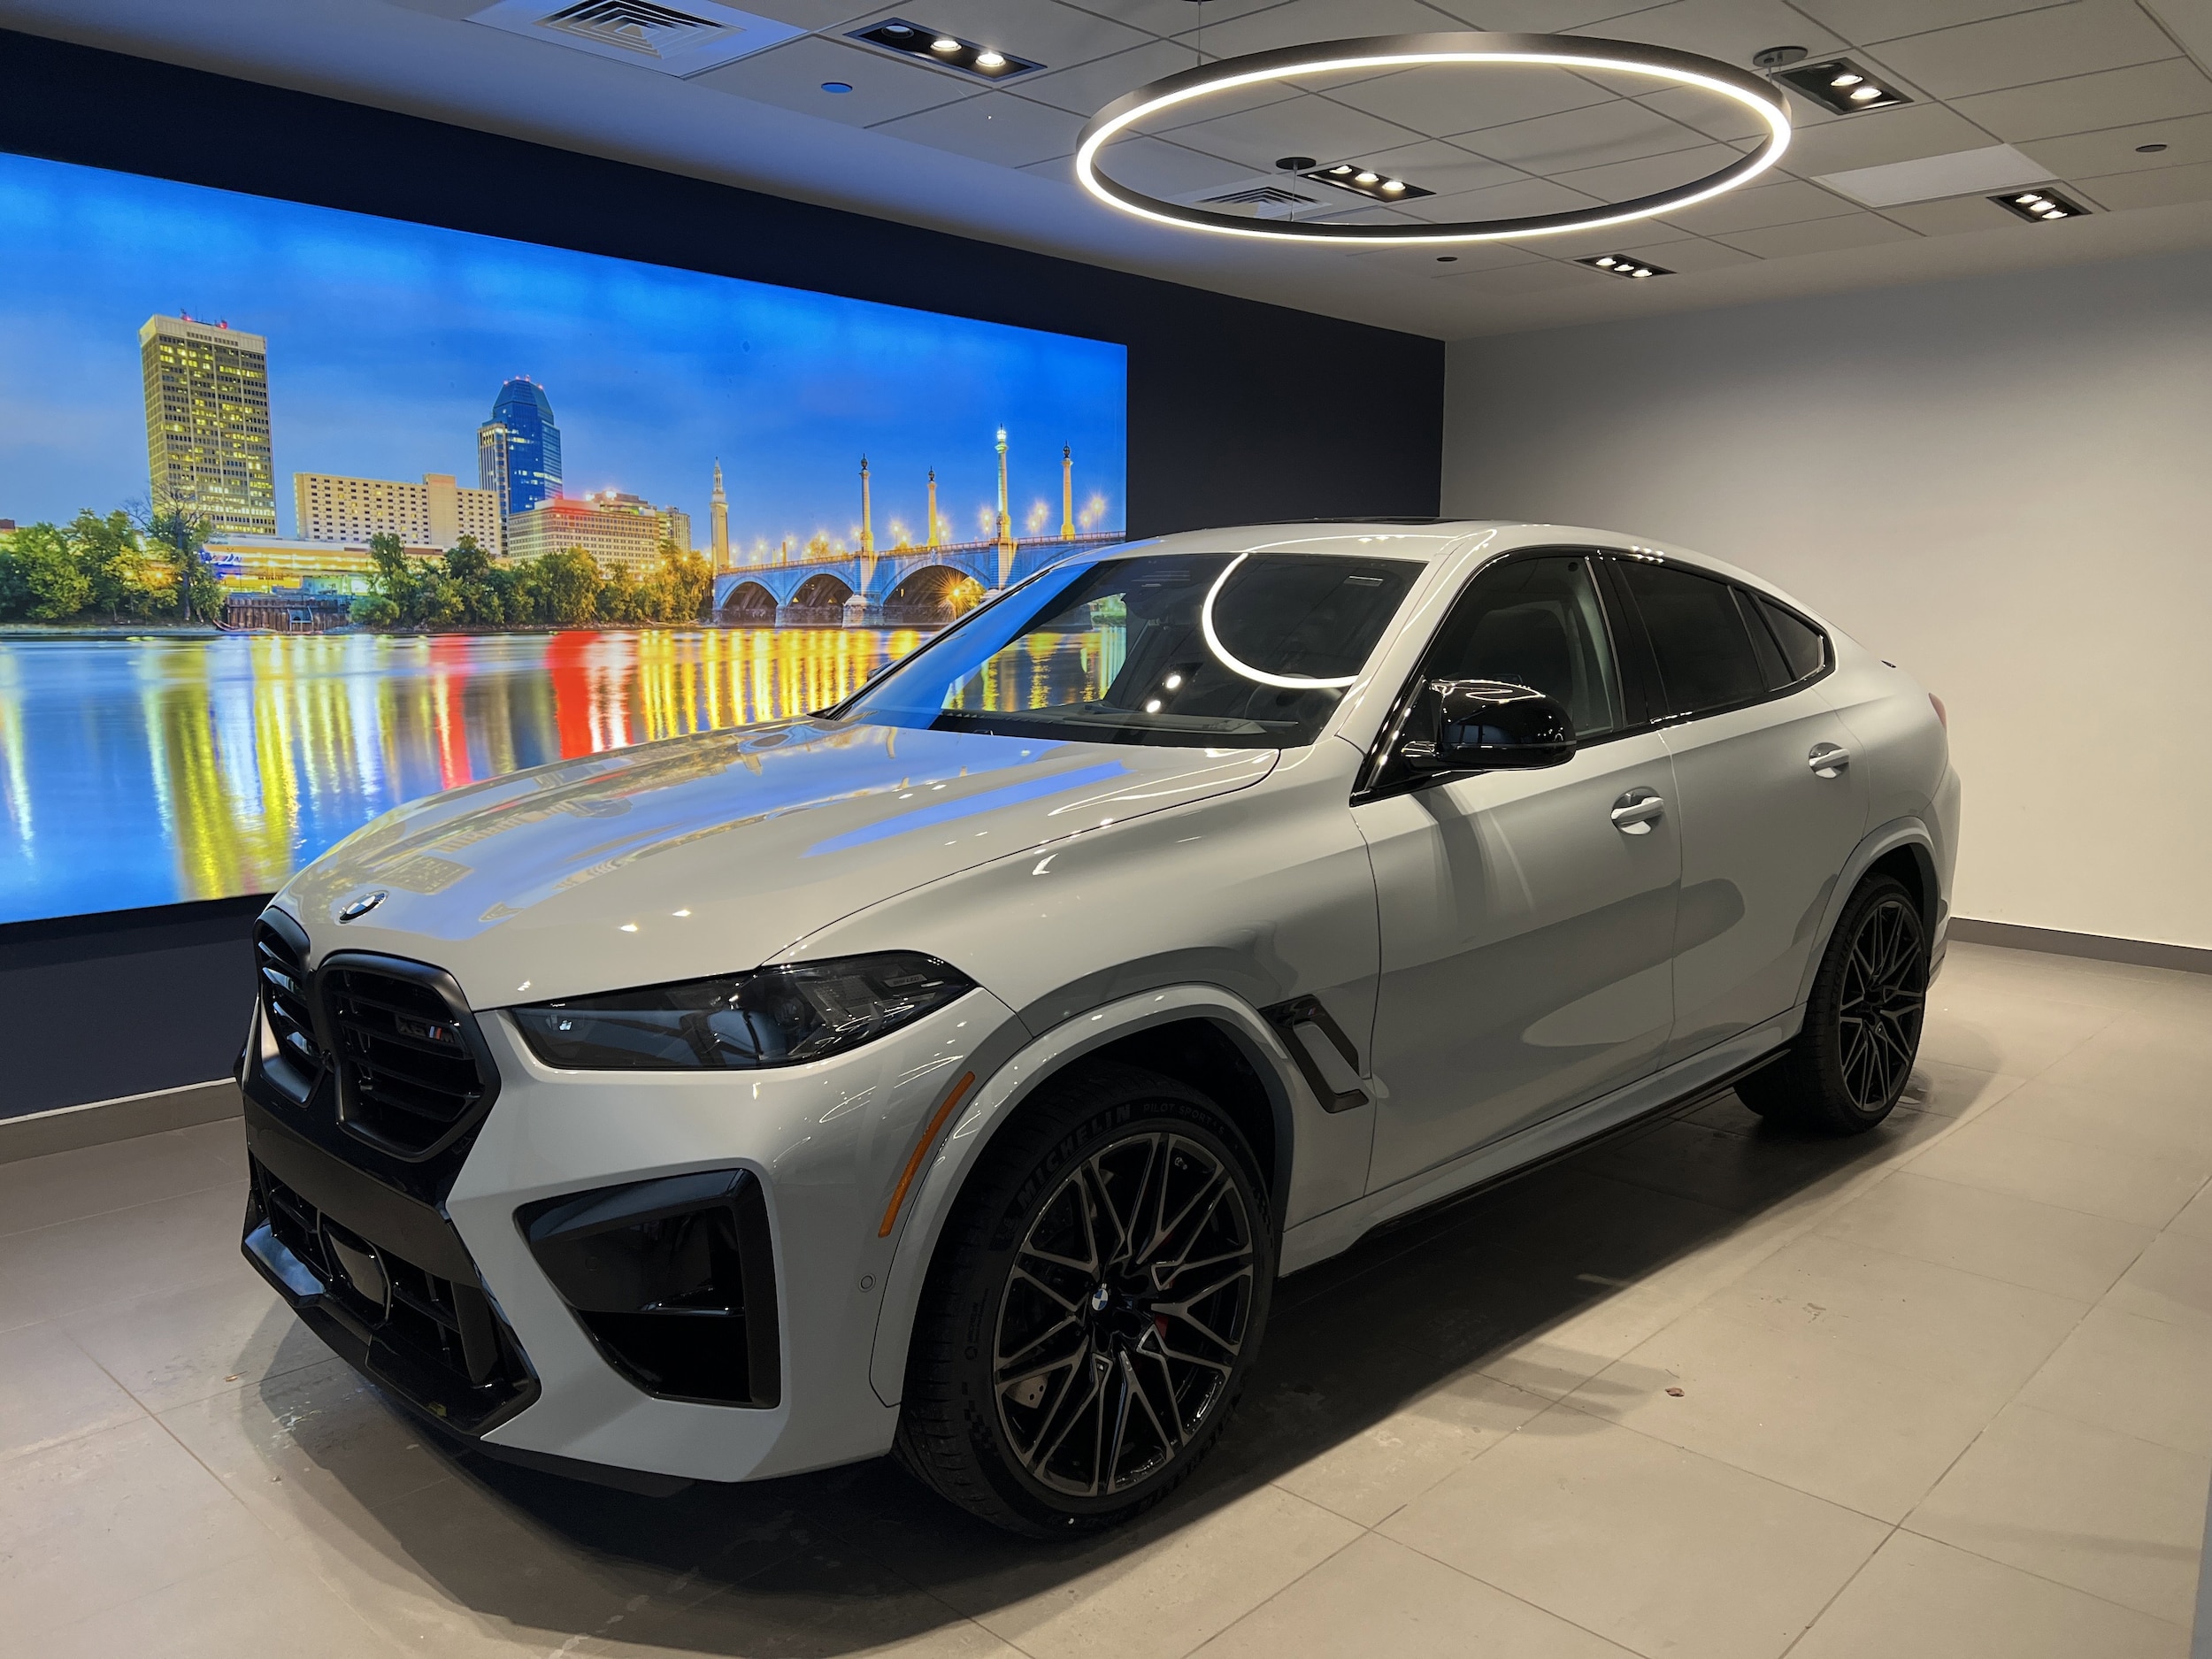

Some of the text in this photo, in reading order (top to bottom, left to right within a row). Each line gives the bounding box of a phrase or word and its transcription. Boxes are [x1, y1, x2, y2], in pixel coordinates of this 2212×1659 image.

[1017, 1103, 1131, 1210] MICHELIN
[1143, 1102, 1175, 1113] PILOT
[1178, 1104, 1213, 1125] SPORT
